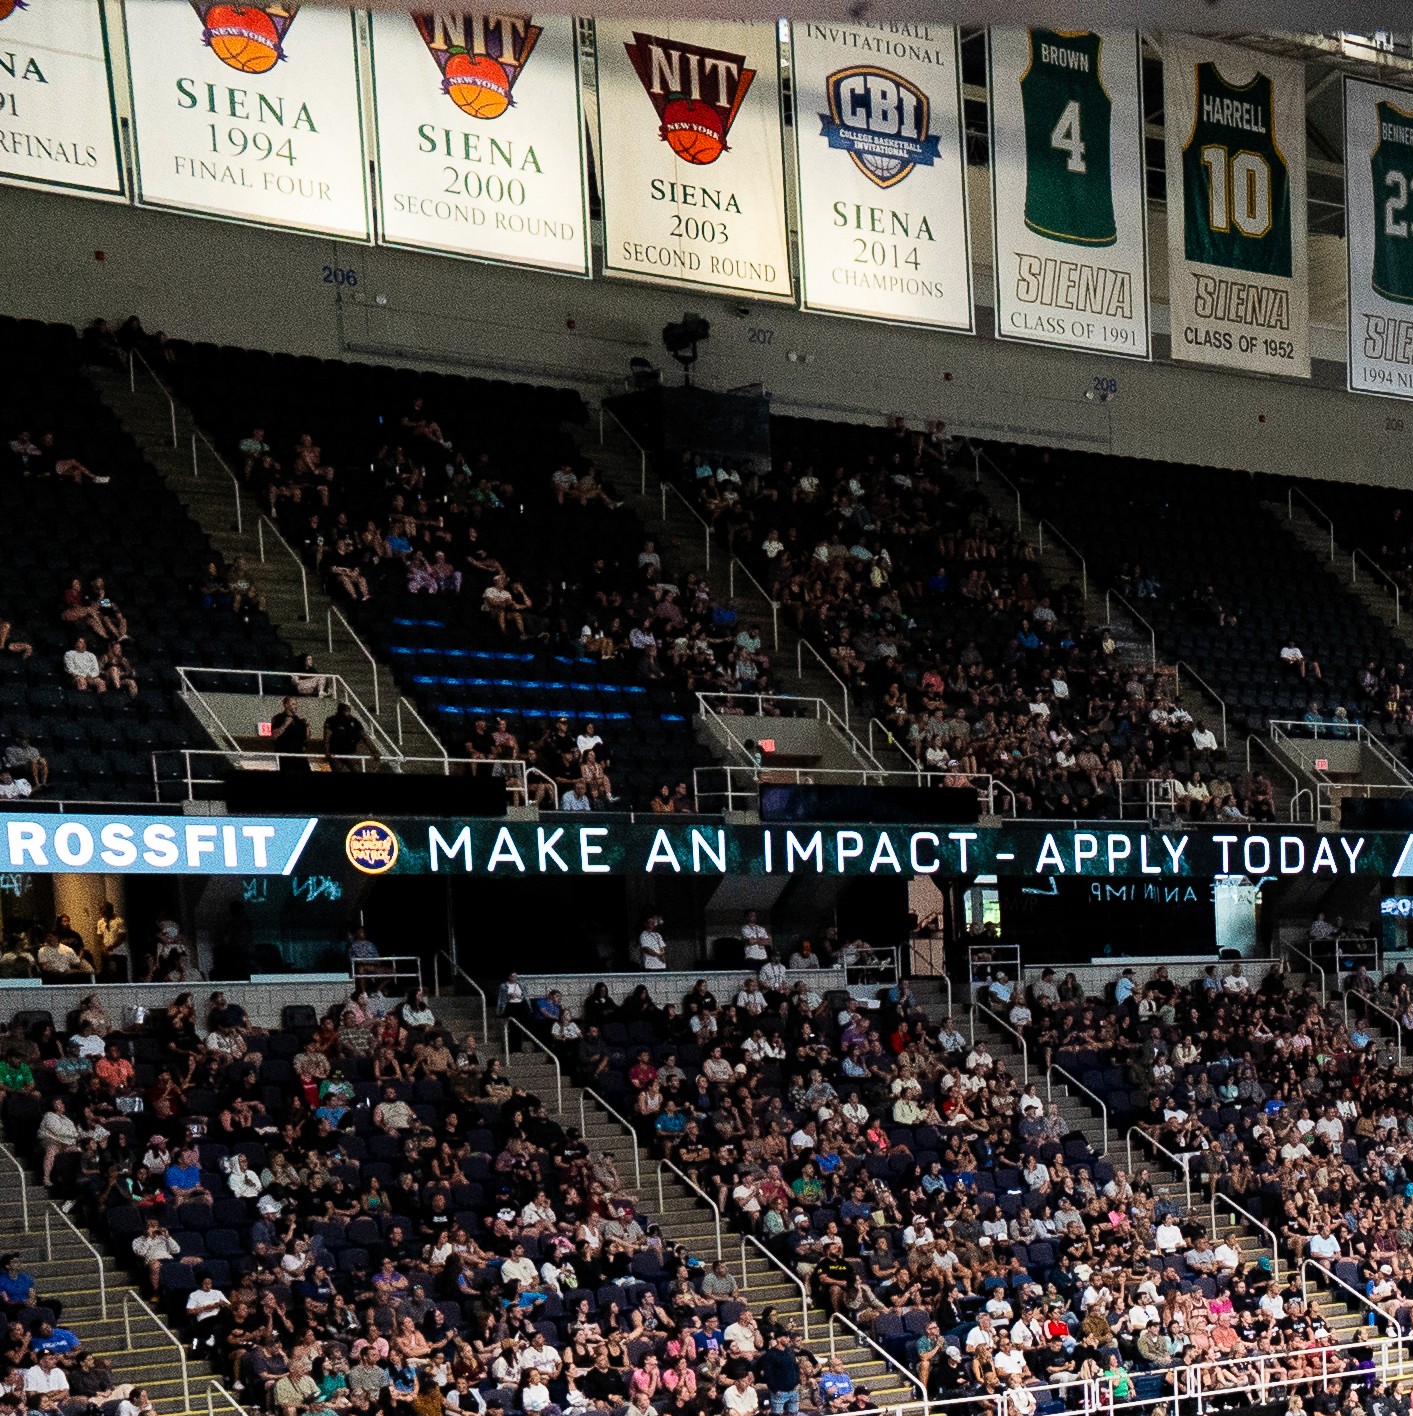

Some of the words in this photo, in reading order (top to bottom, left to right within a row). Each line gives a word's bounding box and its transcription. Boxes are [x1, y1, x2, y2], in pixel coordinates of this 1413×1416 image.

[804, 22, 946, 67] INVITATIONAL
[1040, 42, 1090, 74] BROWN
[649, 42, 738, 109] NIT
[176, 77, 319, 134] SIENA
[839, 73, 920, 139] CBI
[1203, 93, 1267, 134] HARRELL
[206, 122, 298, 167] 1994
[418, 124, 546, 175] SIENA
[1051, 100, 1087, 173] 4
[173, 155, 254, 189] FINAL
[262, 172, 332, 202] FOUR
[443, 166, 527, 208] 2000
[650, 178, 743, 215] SIENA
[1200, 144, 1272, 239] 10
[393, 192, 486, 226] SECOND
[494, 210, 575, 242] ROUND
[669, 214, 730, 244] 2003
[832, 200, 936, 243] SIENA
[321, 265, 358, 288] 206
[622, 241, 703, 273] SECOND
[710, 255, 777, 284] ROUND
[853, 238, 921, 272] 2014
[831, 266, 944, 300] CHAMPIONS
[1013, 252, 1133, 320] SIENA
[1190, 272, 1291, 331] SIENA
[1010, 311, 1066, 336] CLASS
[1071, 318, 1095, 339] OF
[1101, 321, 1139, 348] 1991
[1183, 326, 1233, 352] CLASS
[1236, 335, 1259, 354] OF
[1262, 336, 1294, 361] 1952
[1361, 366, 1392, 386] 1994
[429, 825, 609, 873] MAKE
[646, 827, 727, 873] AN
[762, 829, 974, 874] IMPACT
[1036, 833, 1190, 875] APPLY
[1212, 835, 1367, 875] TODAY
